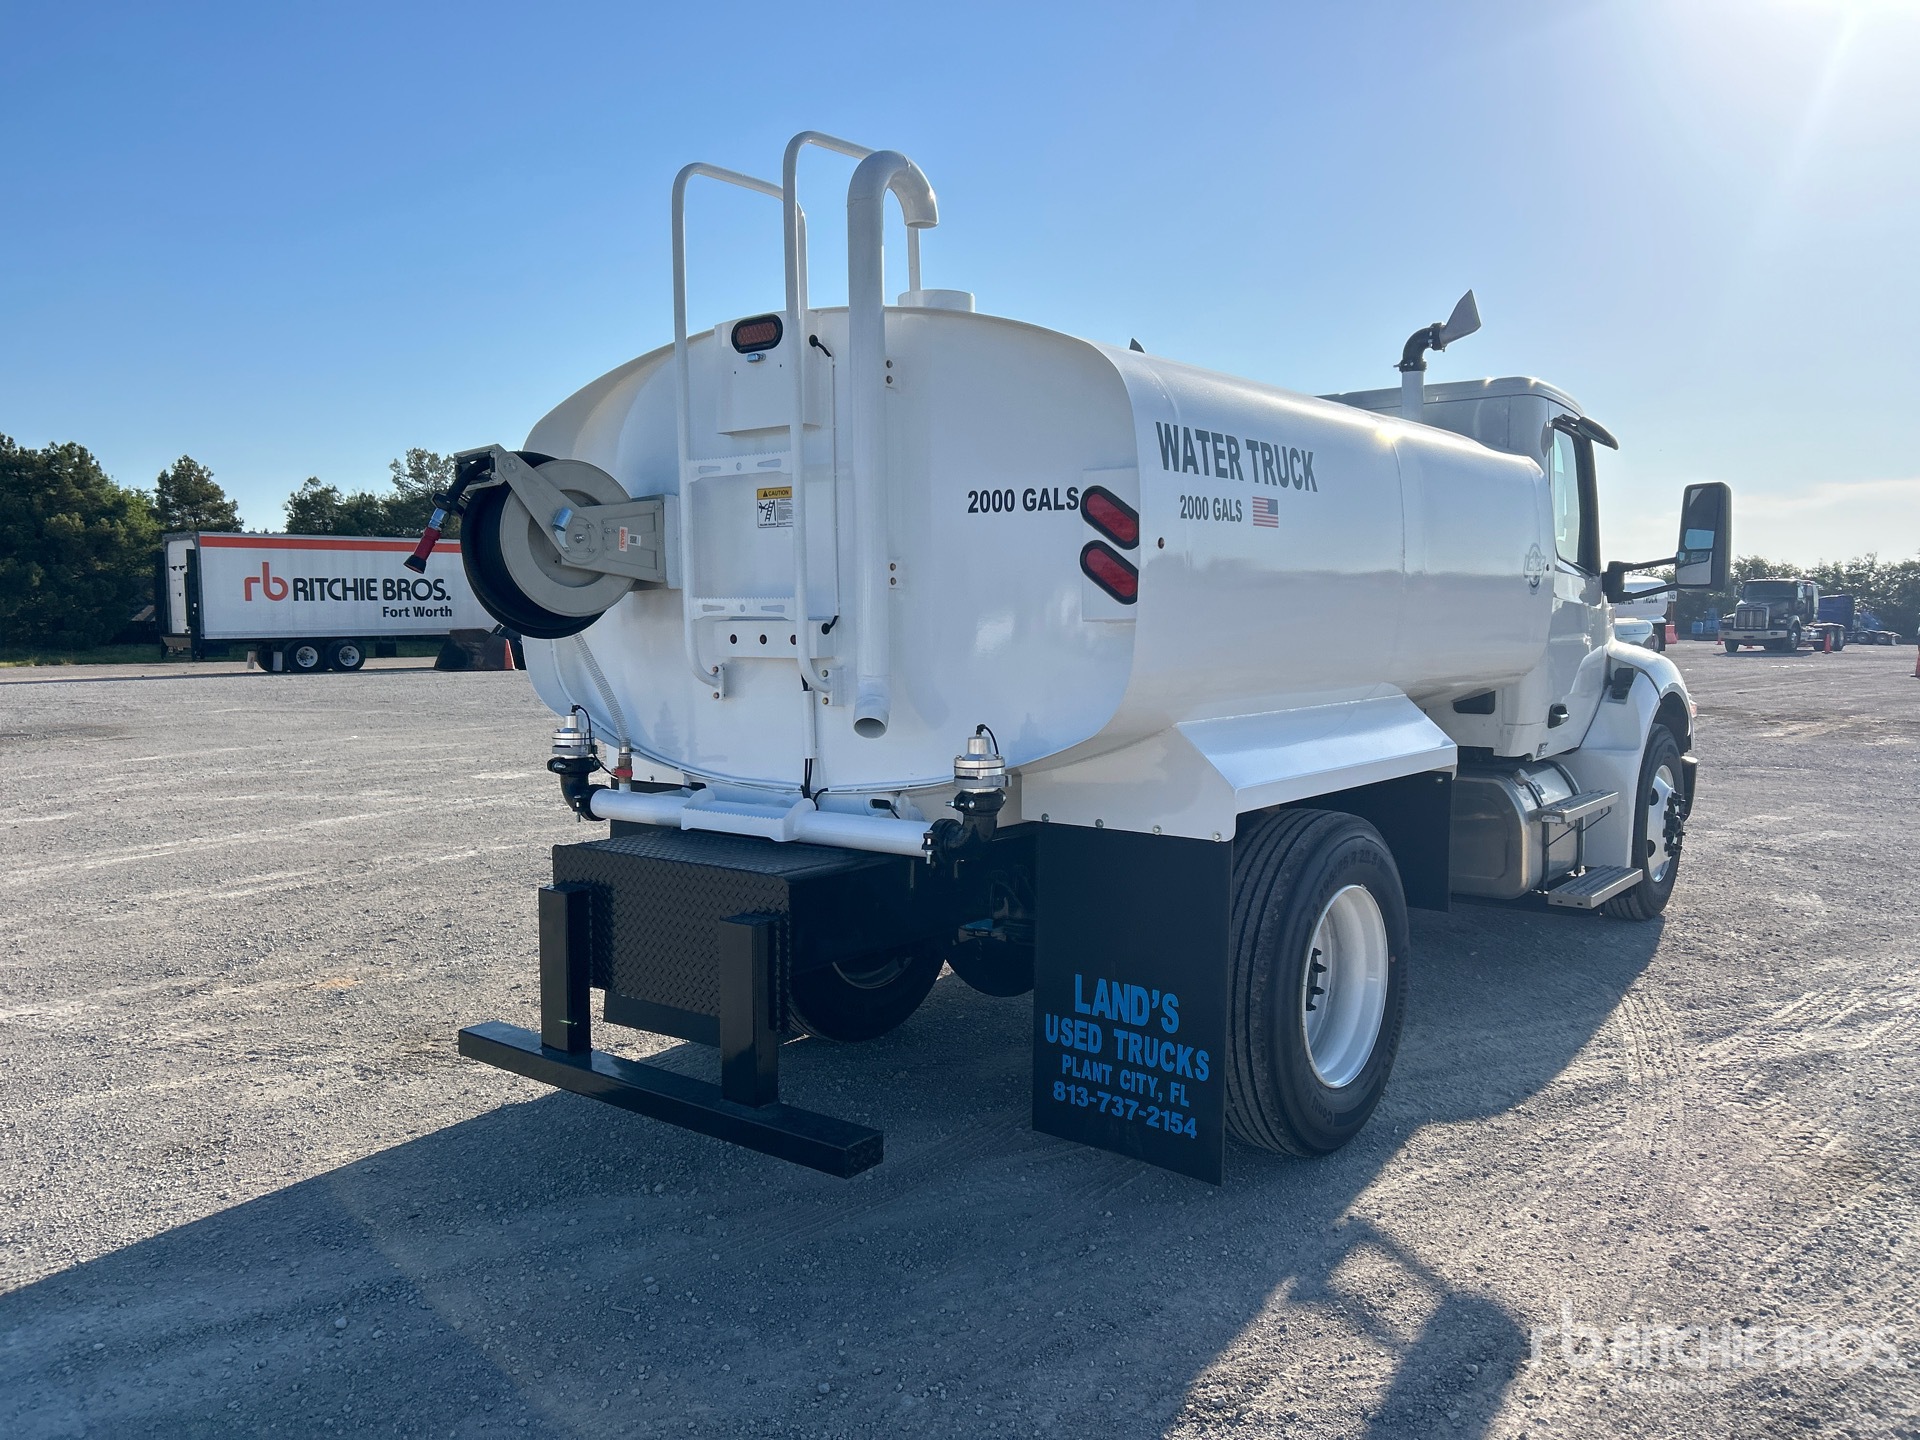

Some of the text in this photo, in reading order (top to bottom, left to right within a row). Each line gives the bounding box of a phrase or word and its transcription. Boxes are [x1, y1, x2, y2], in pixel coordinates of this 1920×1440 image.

[1155, 421, 1318, 493] WATER TRUCK
[967, 486, 1079, 513] 2000 GALS
[1179, 494, 1243, 522] 2000 GALS
[244, 563, 452, 602] rb RITCHIE BROS.
[382, 605, 453, 618] Fort Worth
[1074, 974, 1179, 1034] LAND'S
[1045, 1013, 1210, 1081] USED TRUCKS
[1061, 1054, 1190, 1107] PLANT CITY, FL
[1053, 1080, 1198, 1139] 813-737-2154
